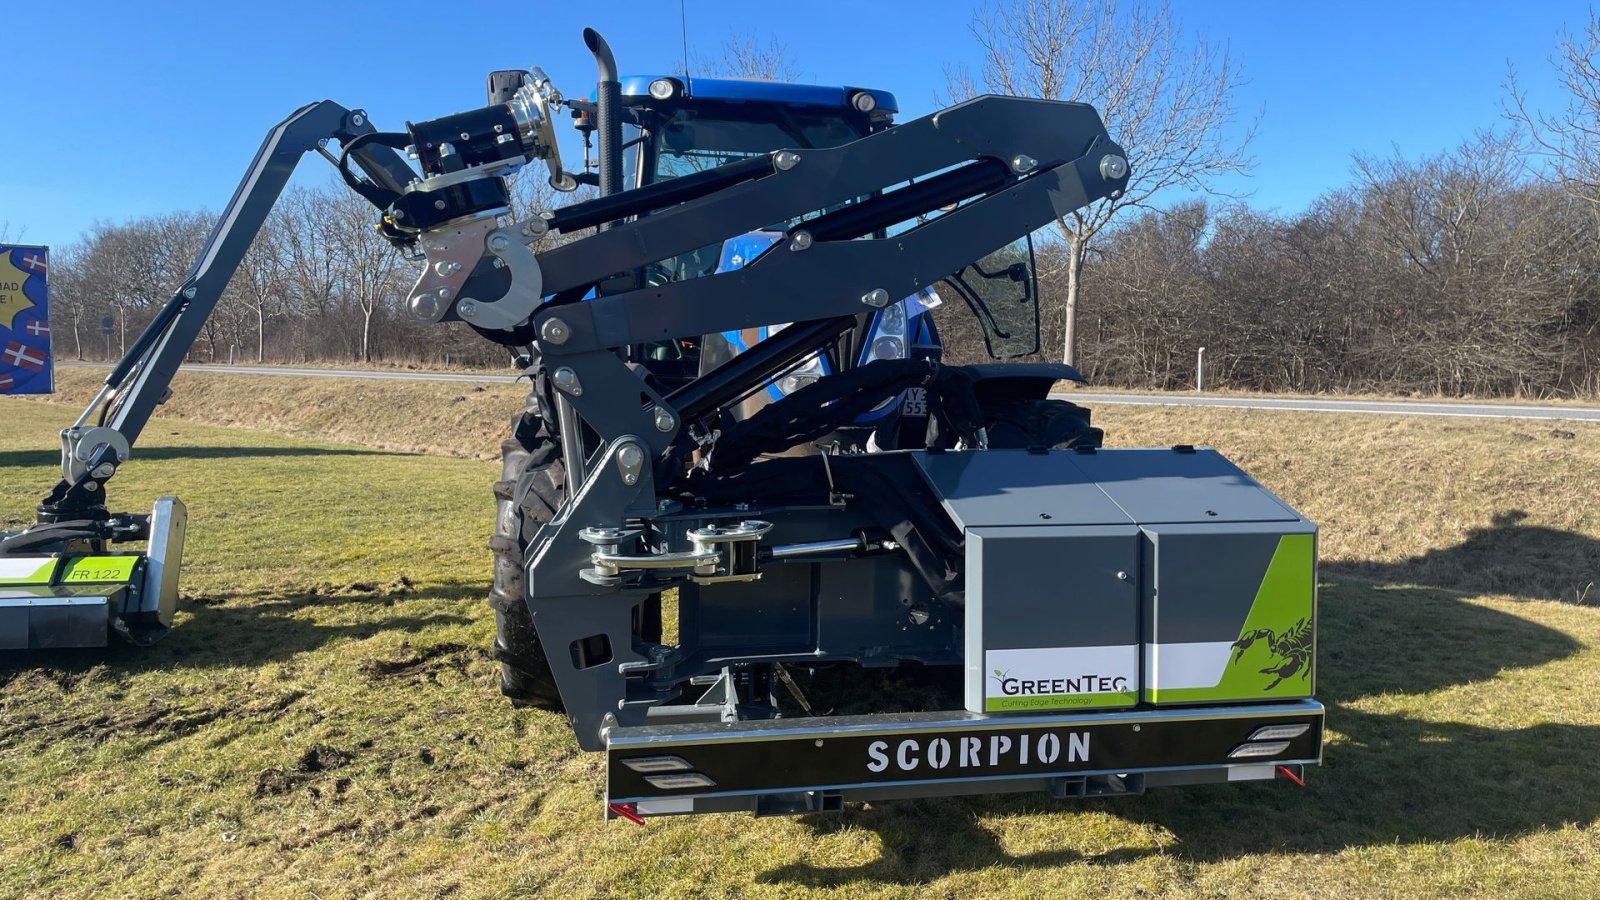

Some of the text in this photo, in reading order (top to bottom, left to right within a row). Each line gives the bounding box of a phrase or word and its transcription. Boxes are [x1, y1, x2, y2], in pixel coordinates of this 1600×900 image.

[72, 569, 121, 580] FR 122
[1001, 696, 1093, 709] Cutting Edge Technology
[866, 731, 1091, 773] SCORPION
